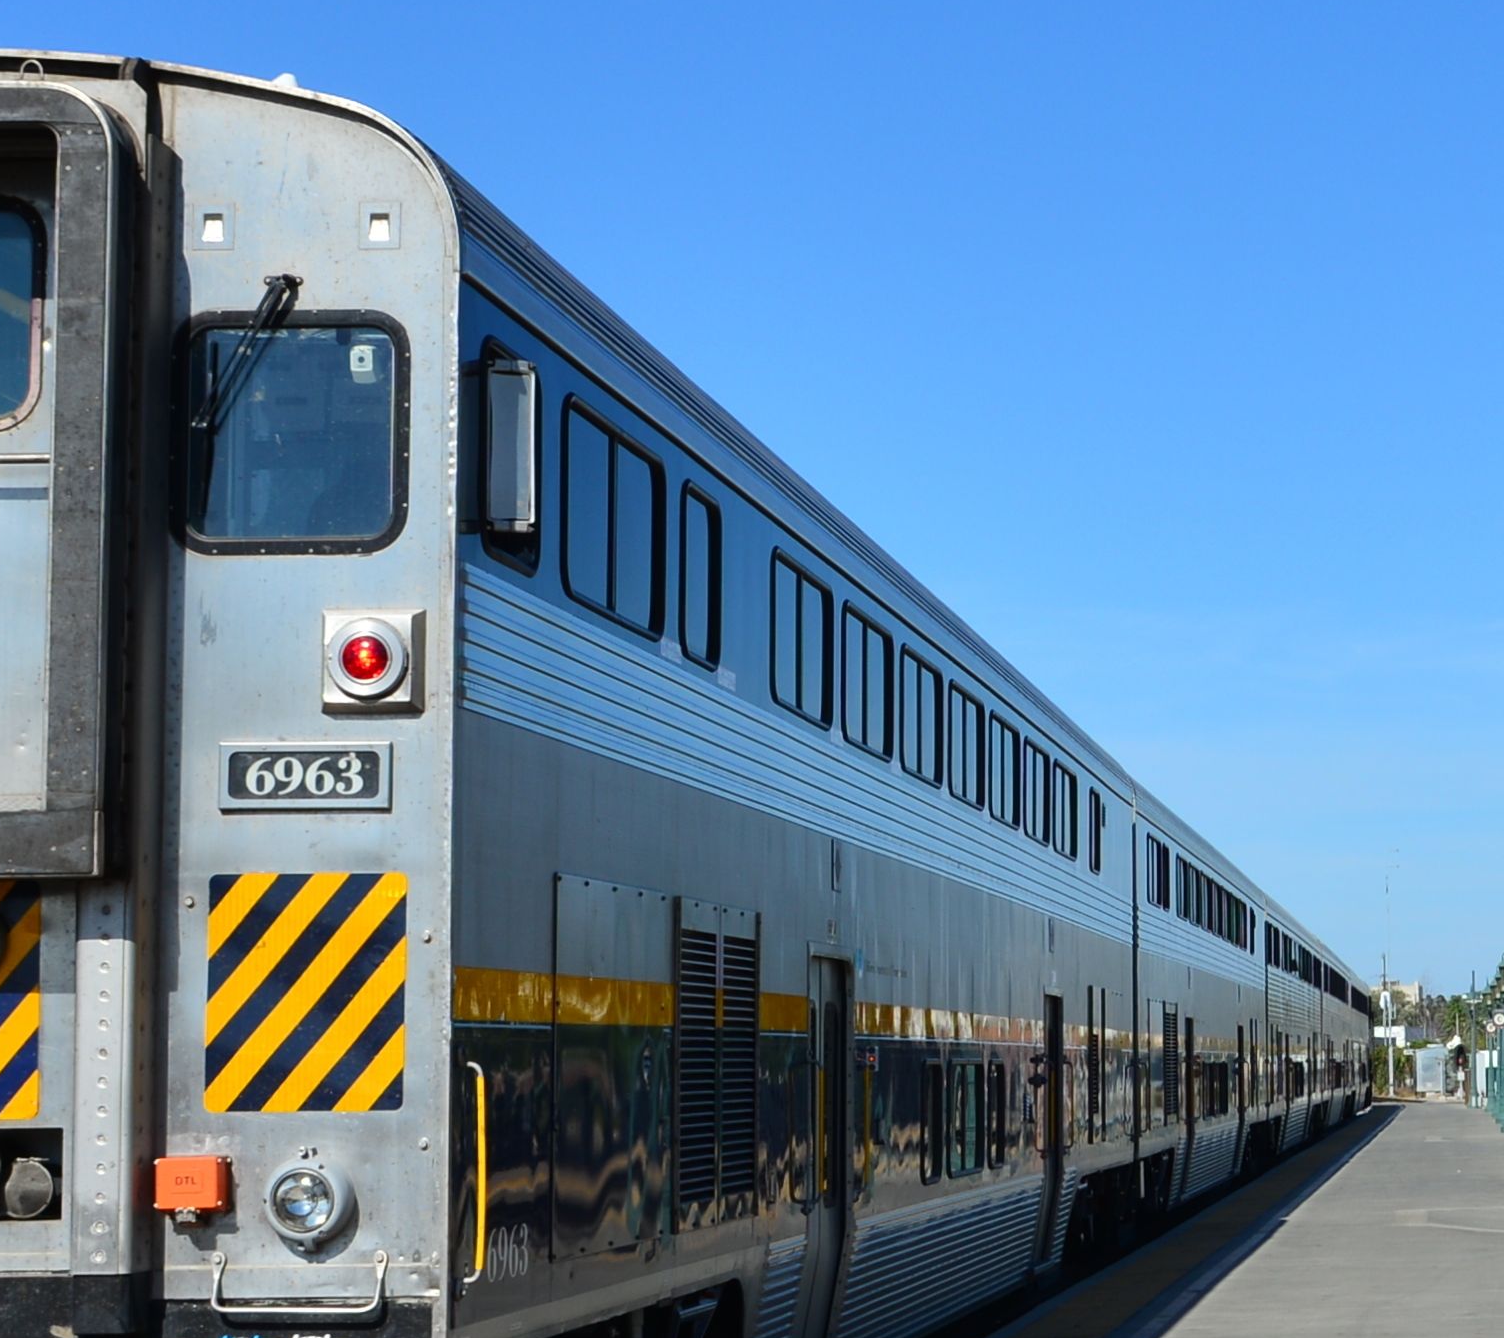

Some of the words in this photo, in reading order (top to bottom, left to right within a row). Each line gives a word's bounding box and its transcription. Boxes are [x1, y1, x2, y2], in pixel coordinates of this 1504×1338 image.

[245, 756, 364, 796] 6963
[174, 1175, 198, 1187] DTL
[486, 1222, 529, 1283] 6963
